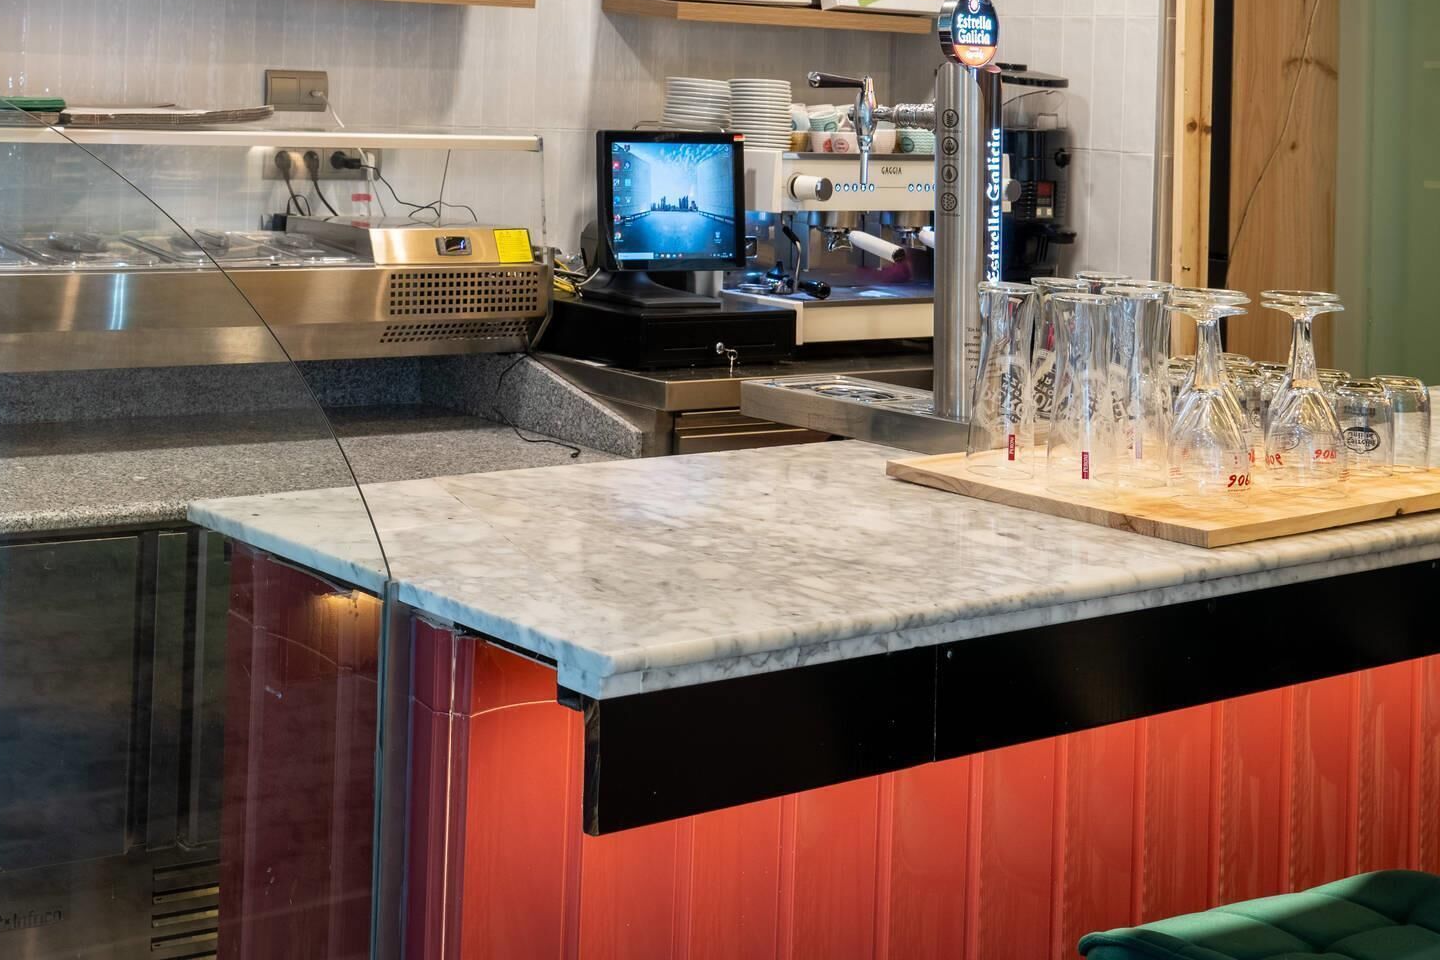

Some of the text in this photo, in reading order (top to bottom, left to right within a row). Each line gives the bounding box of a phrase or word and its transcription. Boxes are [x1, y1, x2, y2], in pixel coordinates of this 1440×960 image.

[957, 13, 992, 30] Estrella
[958, 28, 990, 45] Galicia
[881, 166, 903, 175] GAGGIA
[987, 127, 1000, 287] Estrella Galicia
